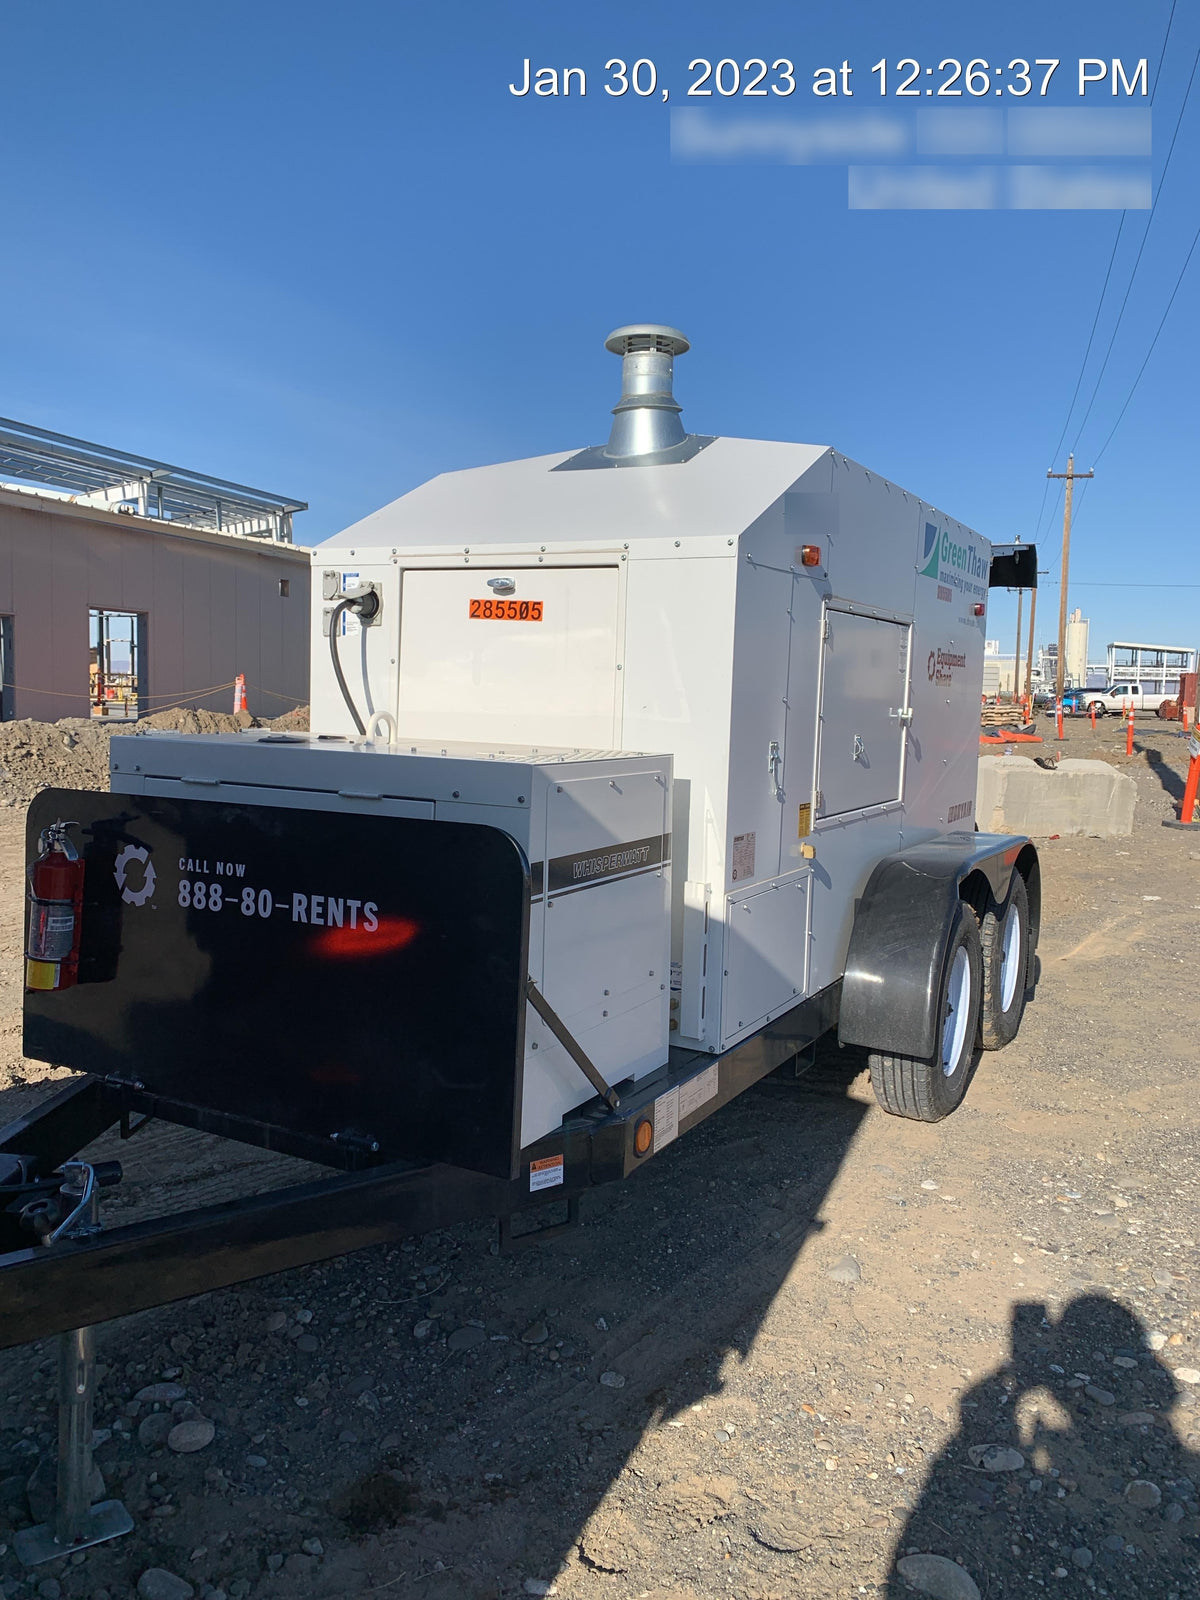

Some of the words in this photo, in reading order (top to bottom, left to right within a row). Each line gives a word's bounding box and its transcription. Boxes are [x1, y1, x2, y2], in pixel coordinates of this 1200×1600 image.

[470, 600, 542, 621] 285505
[179, 857, 209, 874] CALL
[216, 861, 246, 878] NOW
[573, 845, 650, 879] WHISPERWATT
[178, 879, 379, 932] 888-80-RENTS
